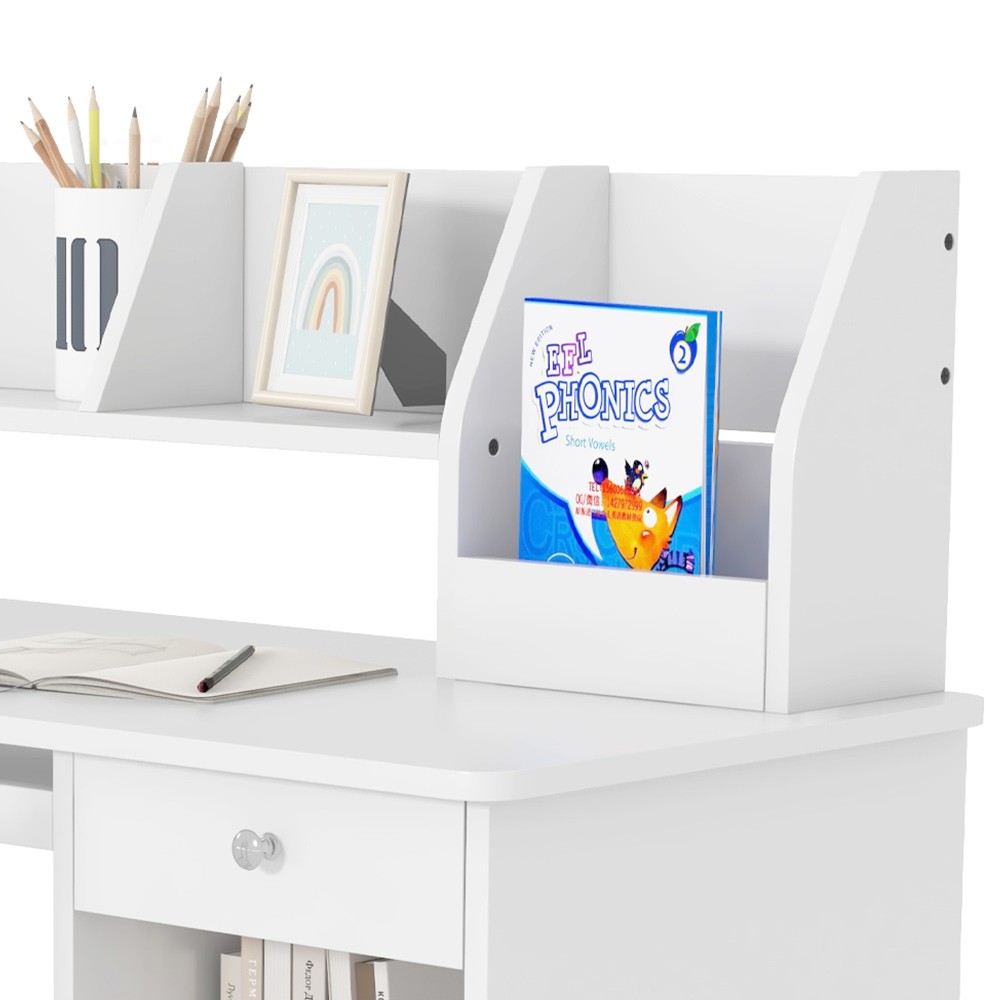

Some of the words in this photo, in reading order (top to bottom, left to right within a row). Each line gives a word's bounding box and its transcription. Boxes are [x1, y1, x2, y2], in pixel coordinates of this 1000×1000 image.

[546, 332, 592, 377] EFL
[678, 345, 686, 364] 2
[534, 371, 671, 443] PHONICS
[565, 434, 587, 448] Short
[588, 437, 616, 451] Vowels
